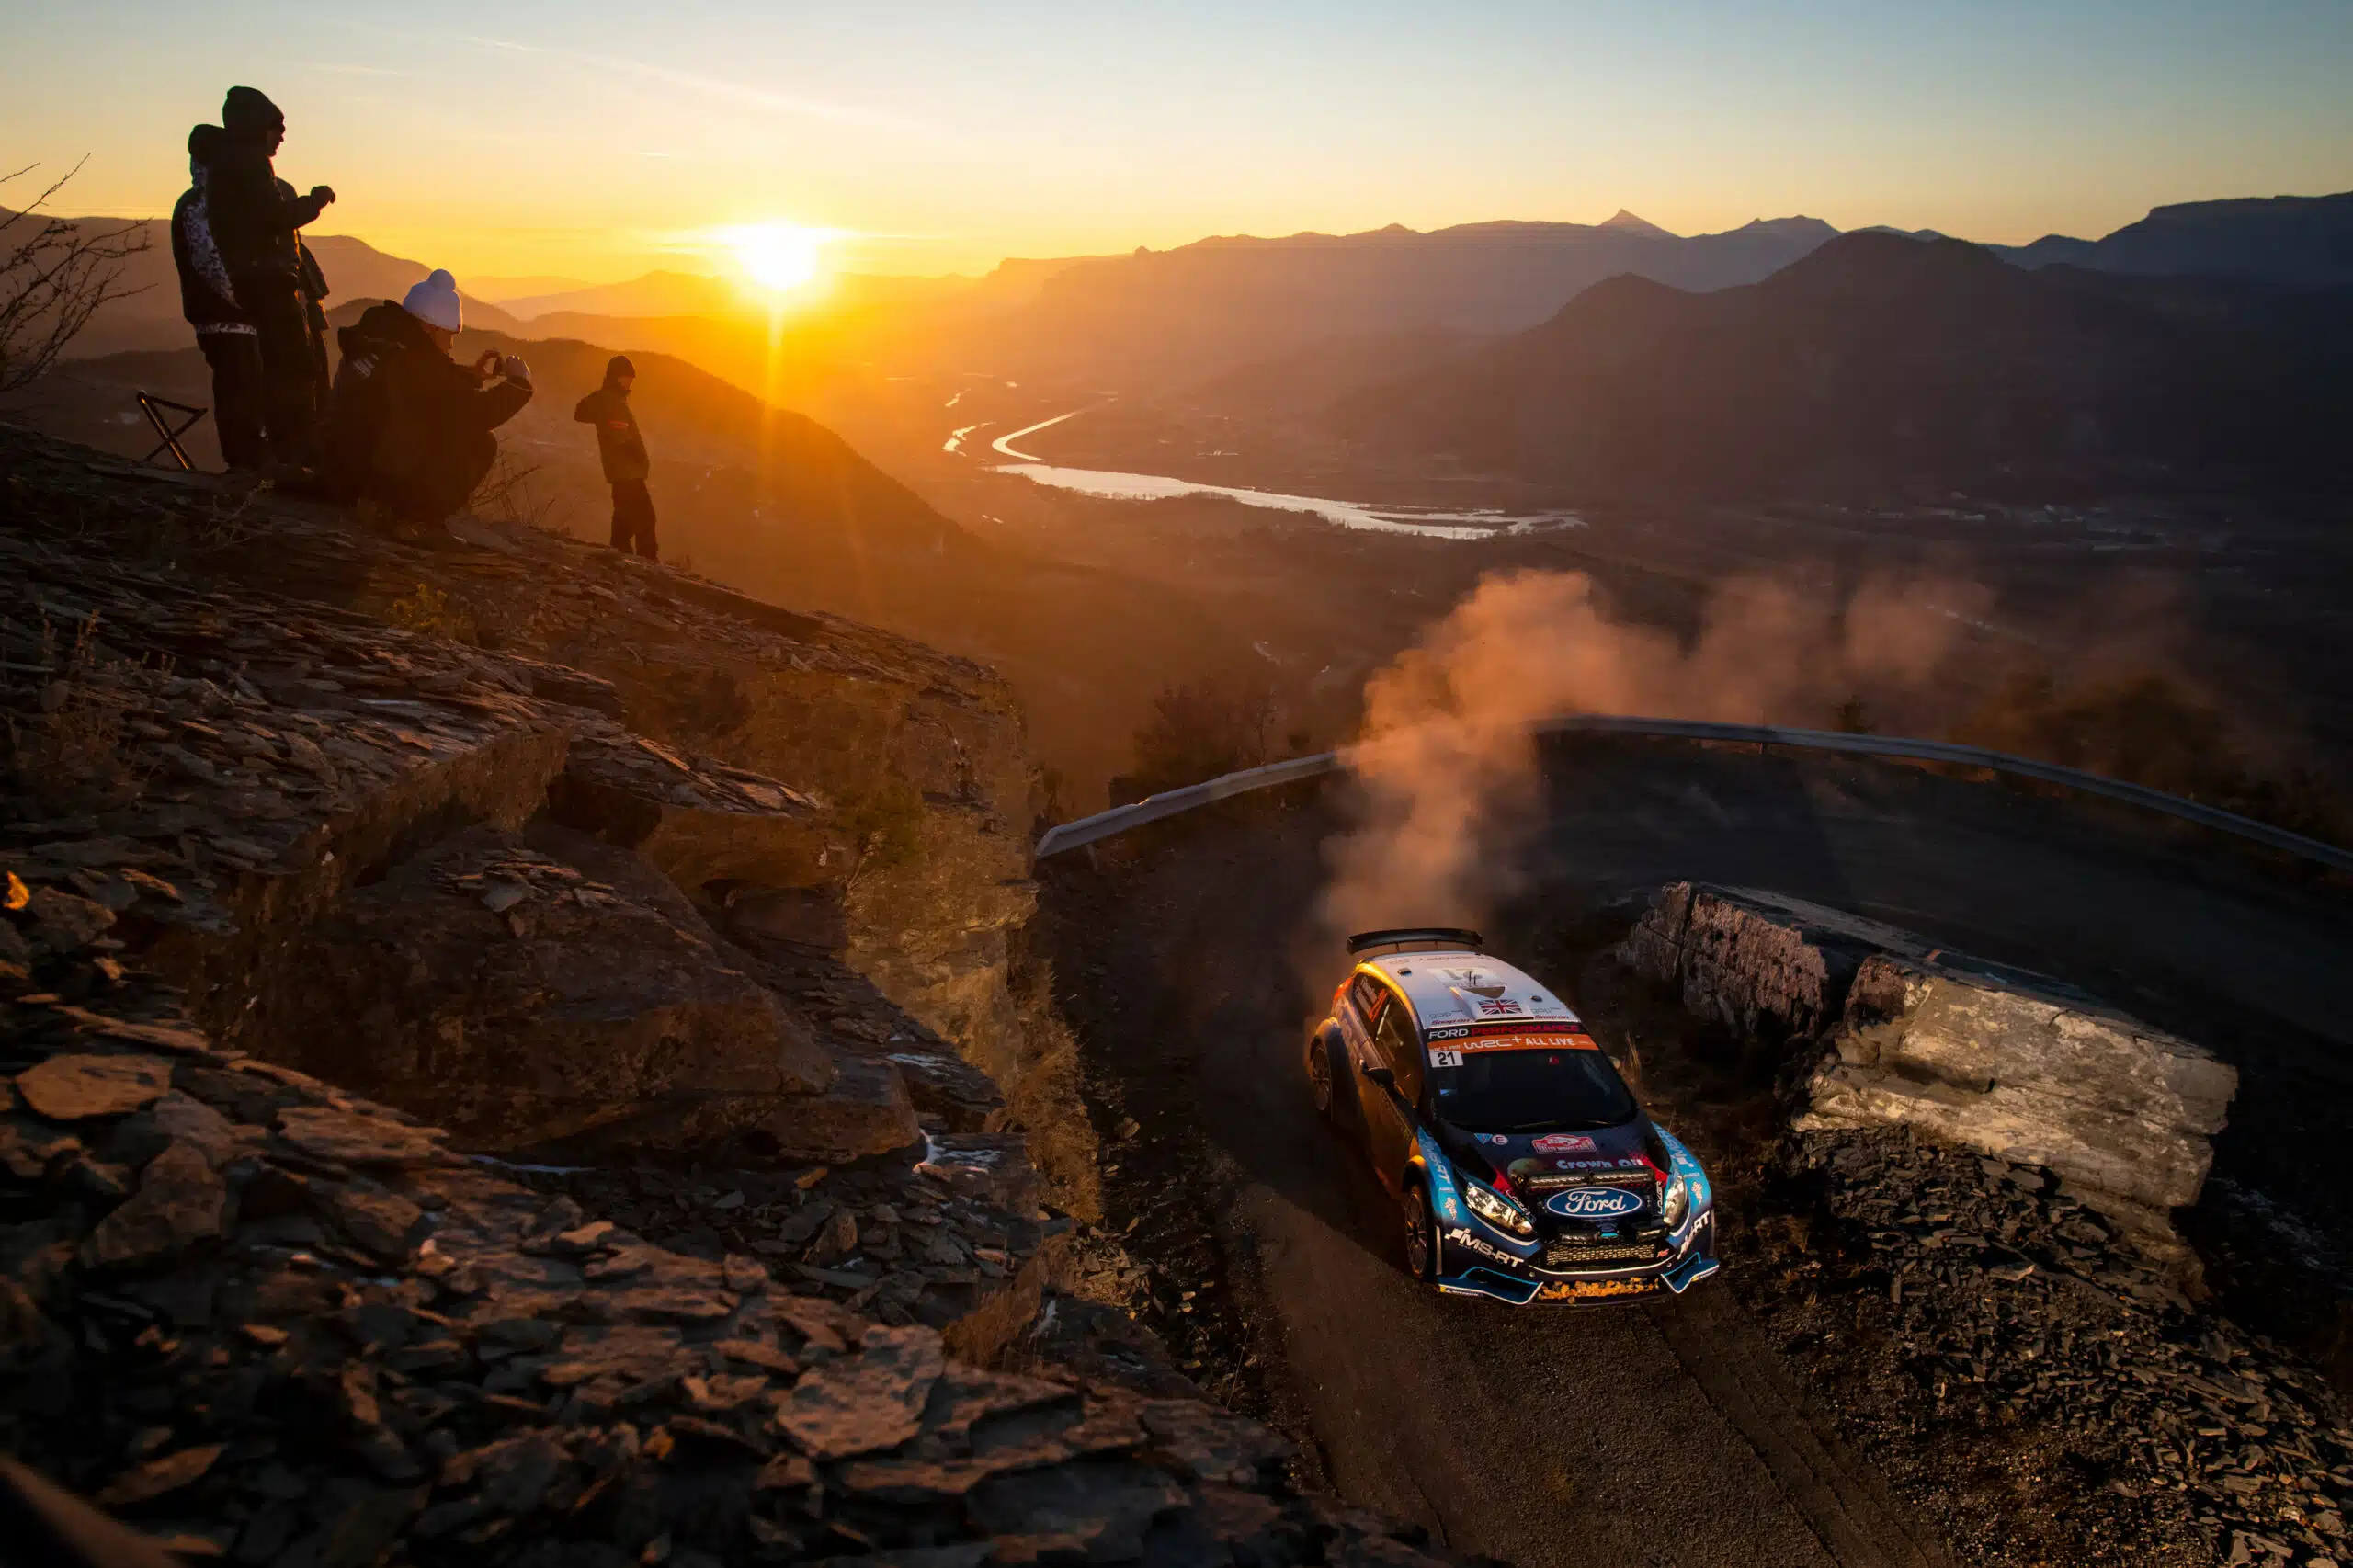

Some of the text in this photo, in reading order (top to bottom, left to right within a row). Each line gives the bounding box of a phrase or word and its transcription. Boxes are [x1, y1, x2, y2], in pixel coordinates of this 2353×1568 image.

[1428, 1024, 1579, 1040] FORD PERFORMANCE
[1525, 1037, 1549, 1046] ALL
[1548, 1037, 1575, 1046] LIVE
[1437, 1051, 1457, 1066] 21
[1495, 1136, 1505, 1144] E
[1556, 1158, 1644, 1170] Crown Oil
[1564, 1190, 1627, 1214] Ford
[1458, 1232, 1525, 1268] MS-RT
